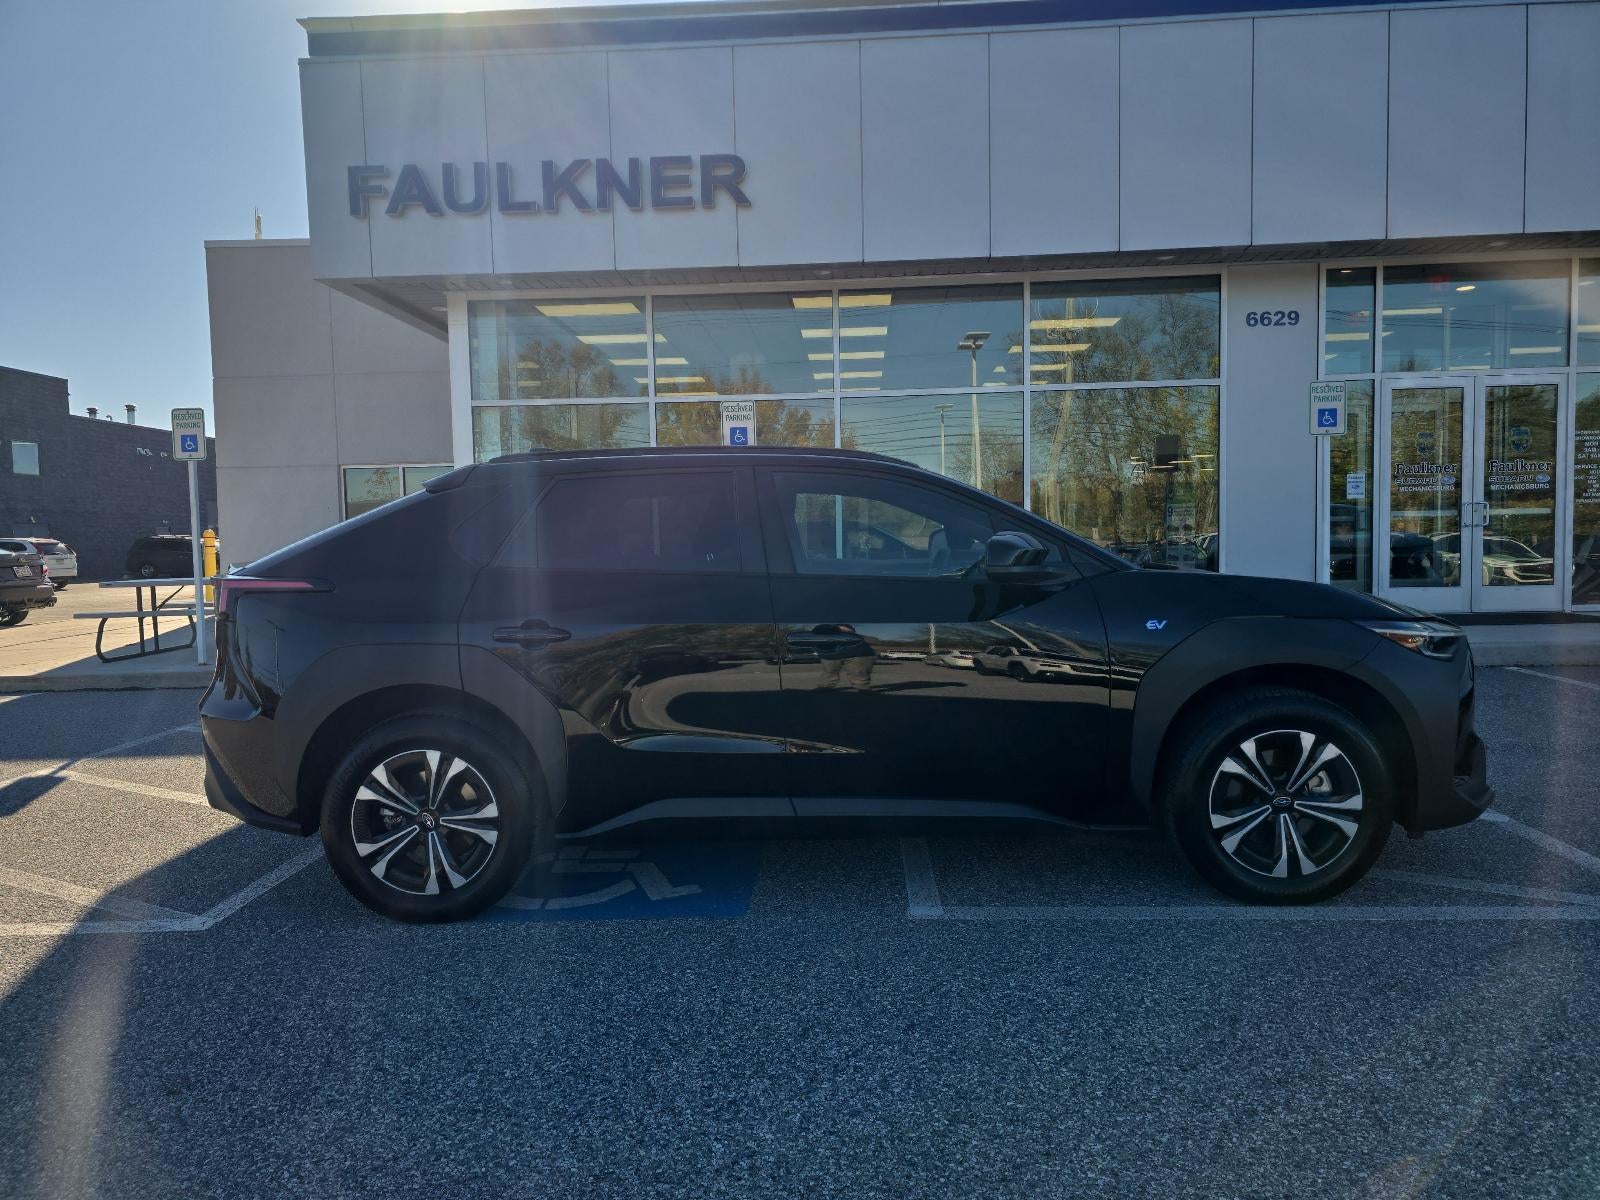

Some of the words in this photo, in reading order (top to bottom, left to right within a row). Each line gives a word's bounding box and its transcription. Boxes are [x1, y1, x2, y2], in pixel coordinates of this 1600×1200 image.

[347, 154, 752, 217] FAULKNER
[1246, 310, 1300, 327] 6629
[1311, 385, 1344, 394] RESERVED
[1313, 395, 1342, 403] PARKING
[724, 404, 753, 412] RESERVED
[173, 413, 202, 421] RESERVED
[725, 413, 752, 421] PARKING
[1395, 462, 1458, 475] Faulkner
[1488, 459, 1553, 472] Faulkner
[1395, 477, 1440, 485] SUBARU
[1399, 484, 1455, 492] MECHANICSBURG
[1490, 483, 1550, 491] MECHANICSBURG
[1145, 619, 1167, 630] EV
